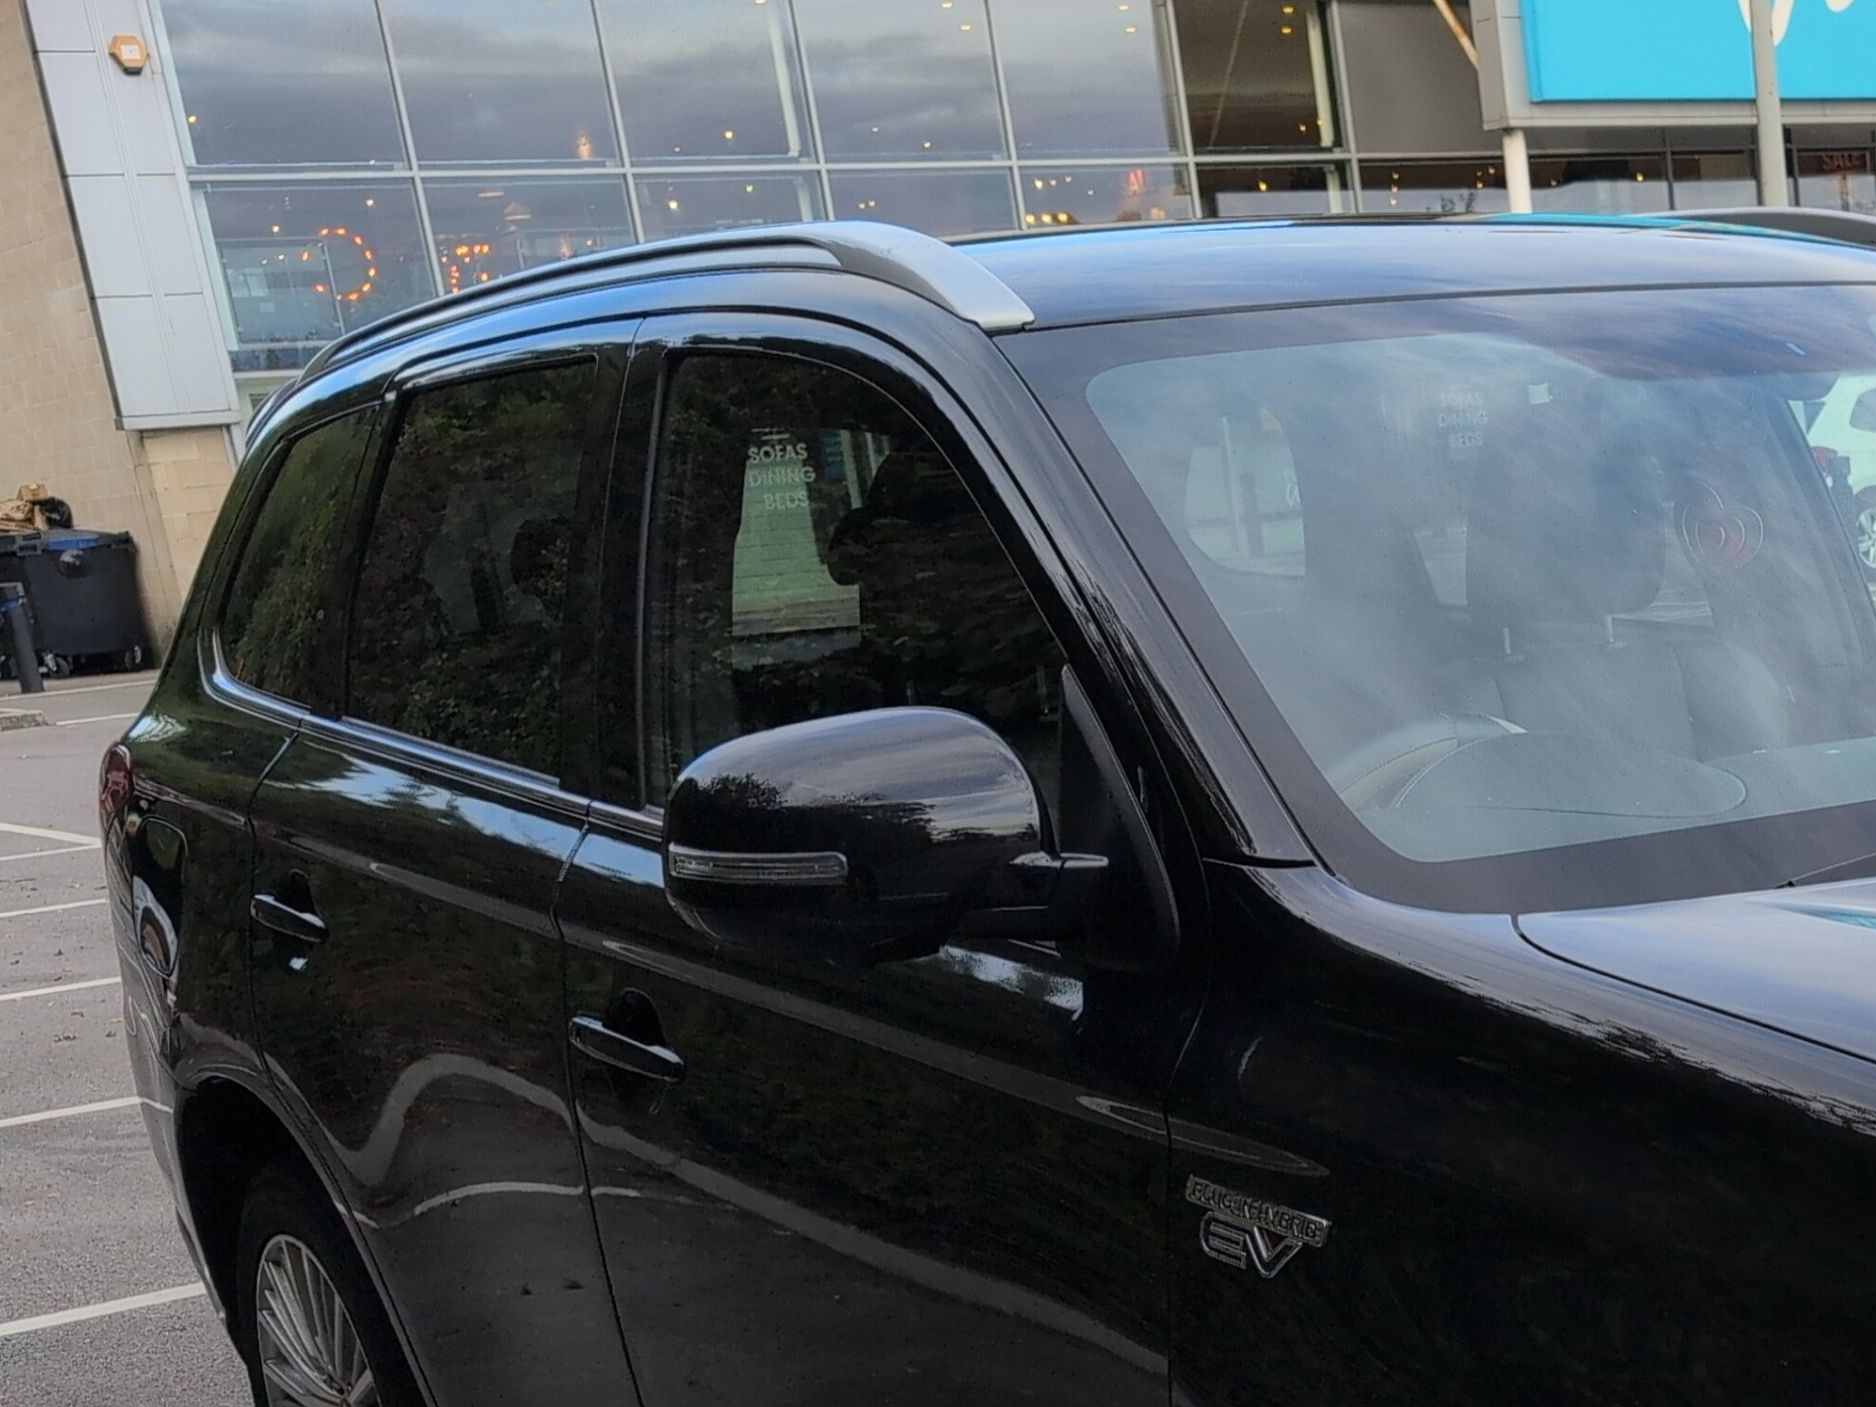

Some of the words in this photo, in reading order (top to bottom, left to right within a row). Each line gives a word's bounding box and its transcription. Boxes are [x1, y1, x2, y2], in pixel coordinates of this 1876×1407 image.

[748, 443, 808, 464] SOFAS
[750, 466, 816, 487] DINING
[764, 491, 809, 510] BEDS
[1199, 1210, 1303, 1279] EV
